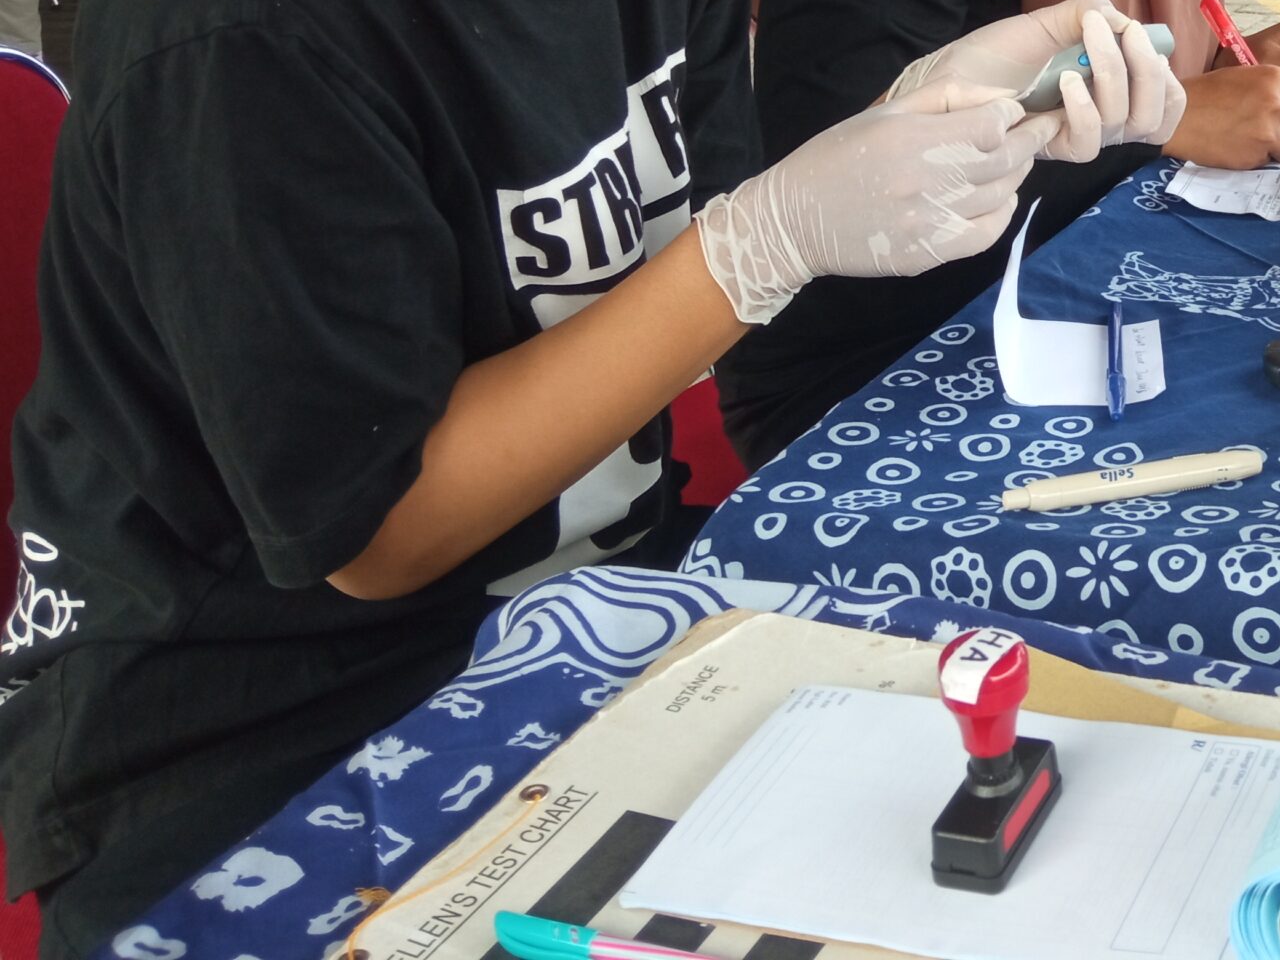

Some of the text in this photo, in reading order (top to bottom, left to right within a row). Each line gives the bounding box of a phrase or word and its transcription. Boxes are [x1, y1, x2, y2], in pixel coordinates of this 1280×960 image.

[1100, 467, 1134, 482] Sella
[665, 665, 719, 713] DISTANCE
[466, 844, 528, 890] TEST
[519, 785, 590, 844] CHART
